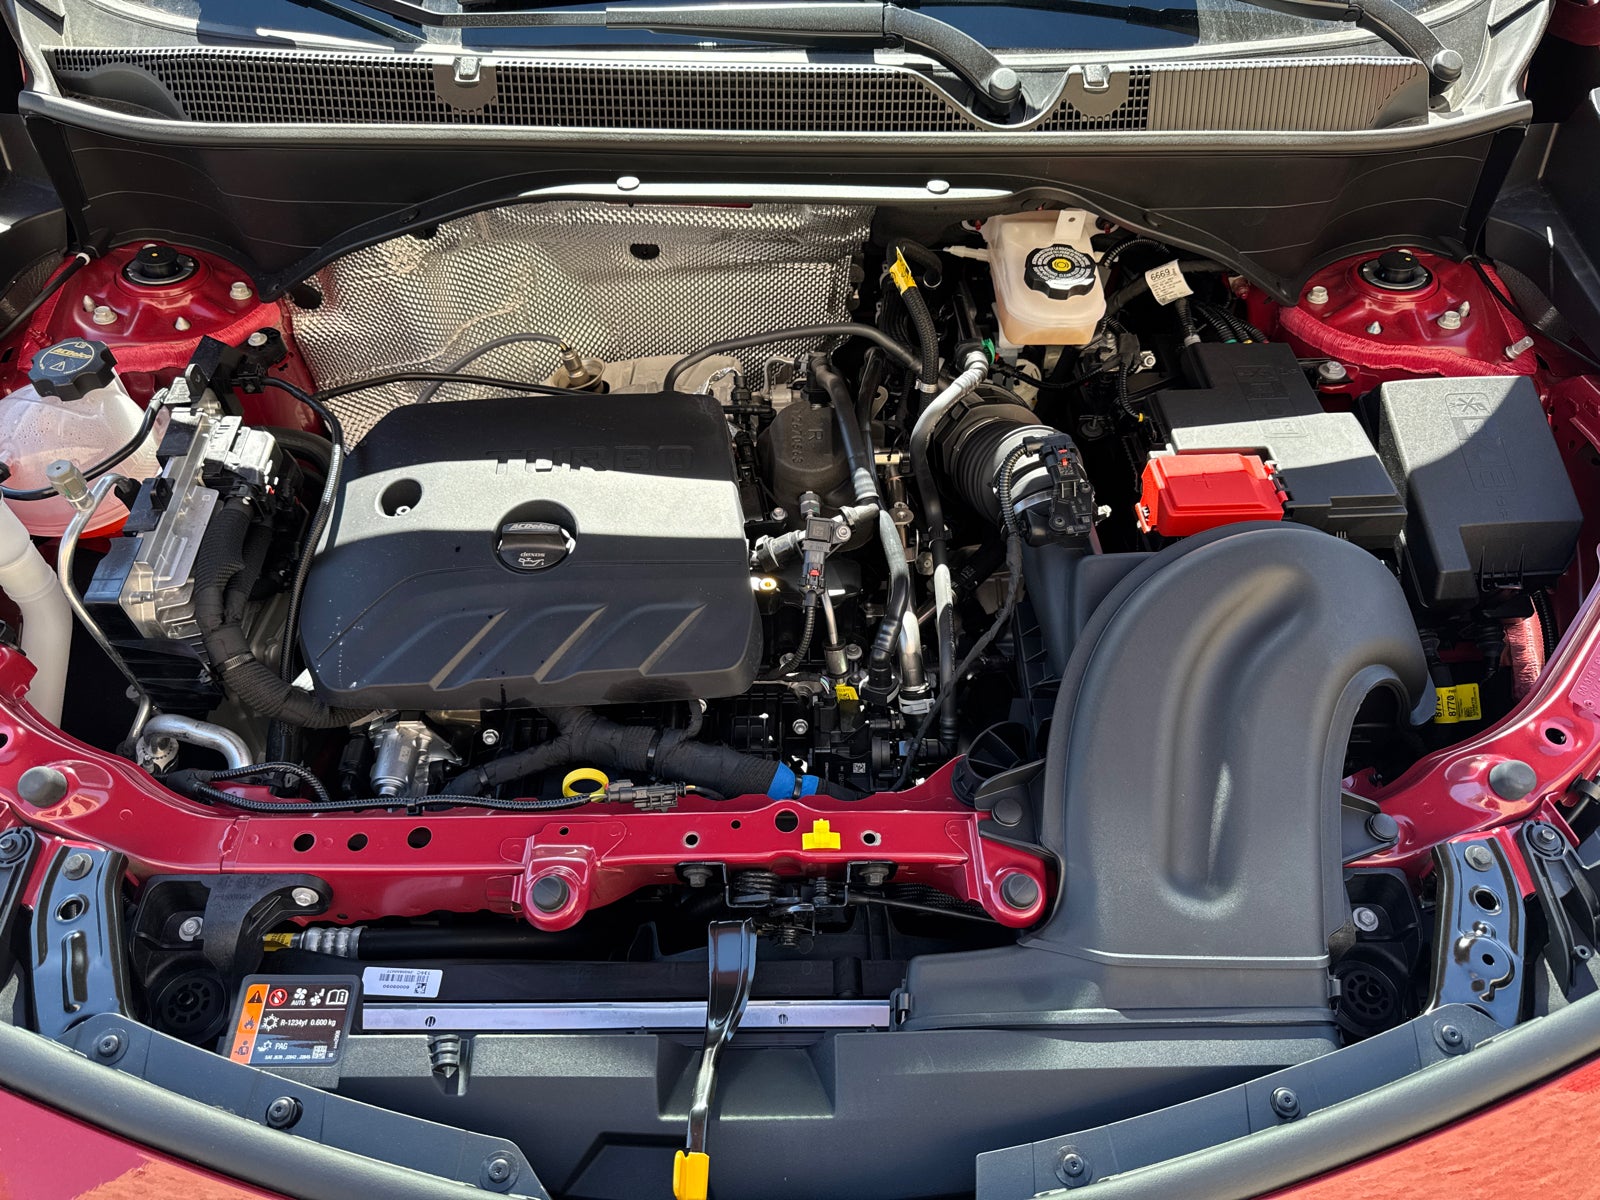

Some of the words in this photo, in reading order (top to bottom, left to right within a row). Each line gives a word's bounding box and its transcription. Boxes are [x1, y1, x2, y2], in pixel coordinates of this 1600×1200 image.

[1151, 268, 1170, 281] 6669
[808, 428, 824, 442] R
[485, 444, 694, 475] TURBO
[508, 523, 555, 531] ACDelco
[1446, 694, 1456, 717] 8770
[280, 1018, 308, 1028] R-1234yf
[310, 1018, 328, 1026] 0.600
[328, 1019, 336, 1027] kg
[274, 1042, 289, 1050] PAG
